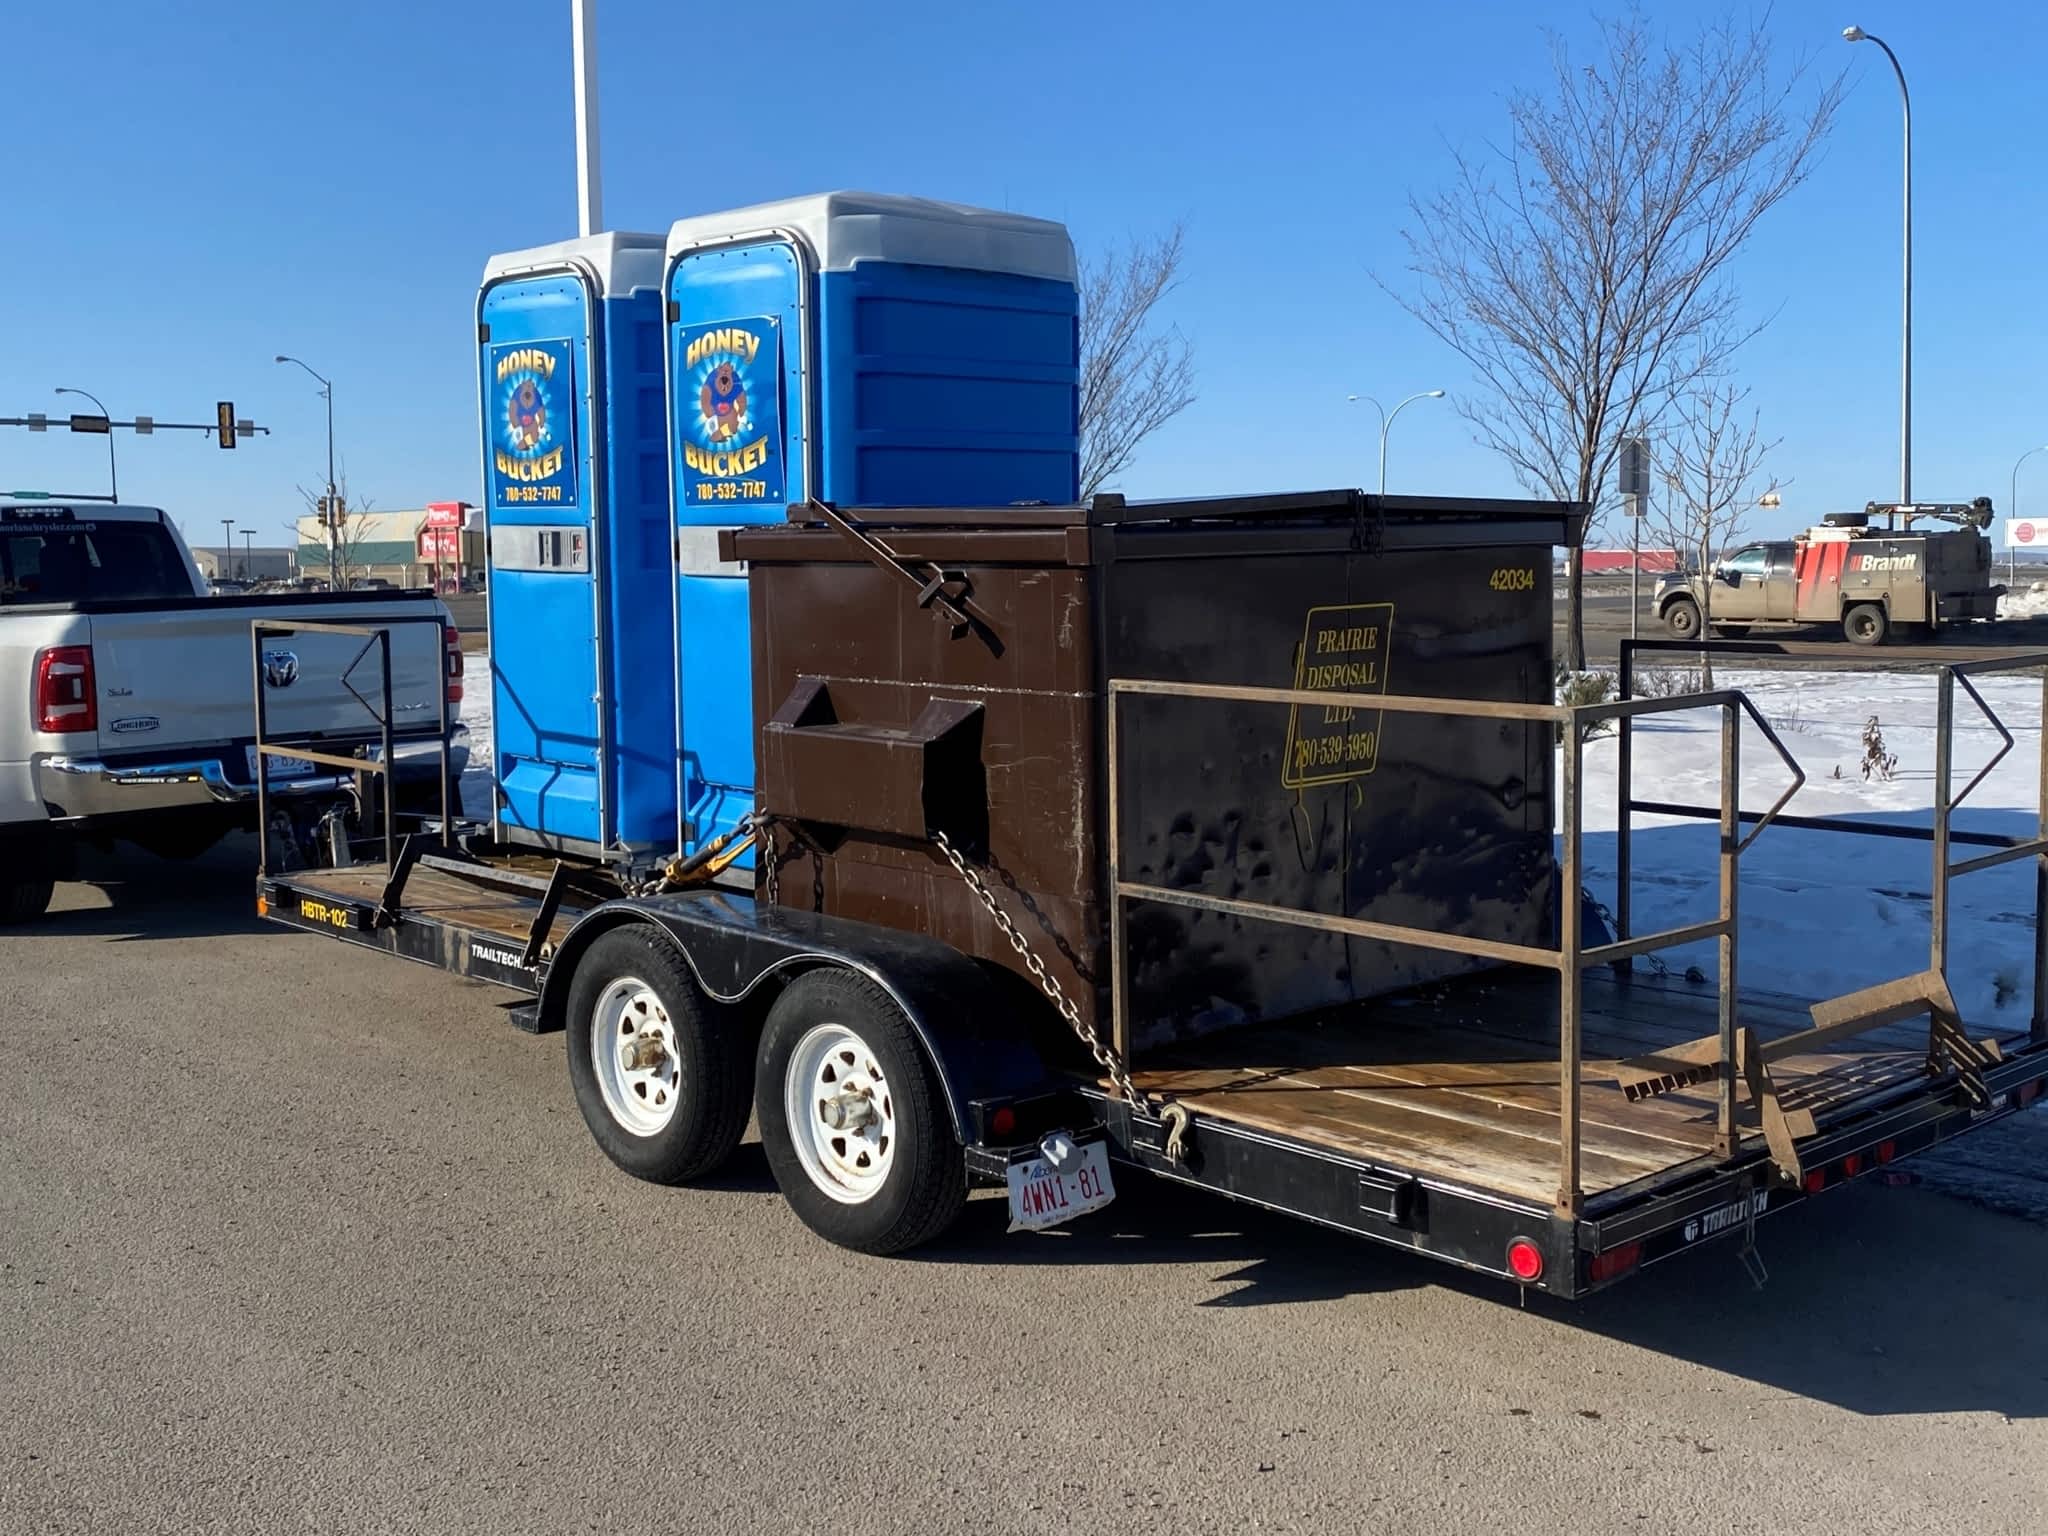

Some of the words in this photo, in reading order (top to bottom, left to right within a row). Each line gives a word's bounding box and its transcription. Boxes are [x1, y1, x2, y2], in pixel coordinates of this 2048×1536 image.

[686, 328, 760, 370] HONEY
[497, 349, 556, 384] HONEY
[496, 445, 563, 482] BUCKET
[684, 435, 769, 478] BUCKET
[505, 486, 562, 502] 780-532-7747
[696, 481, 766, 500] 780-532-7747
[1861, 553, 1917, 572] Brandt
[1489, 568, 1535, 591] 42034
[1316, 626, 1378, 654] PRAIRIE
[1307, 662, 1377, 690] DISPOSAL
[1296, 732, 1374, 768] 780-539-5950
[301, 899, 348, 928] HBTR-102
